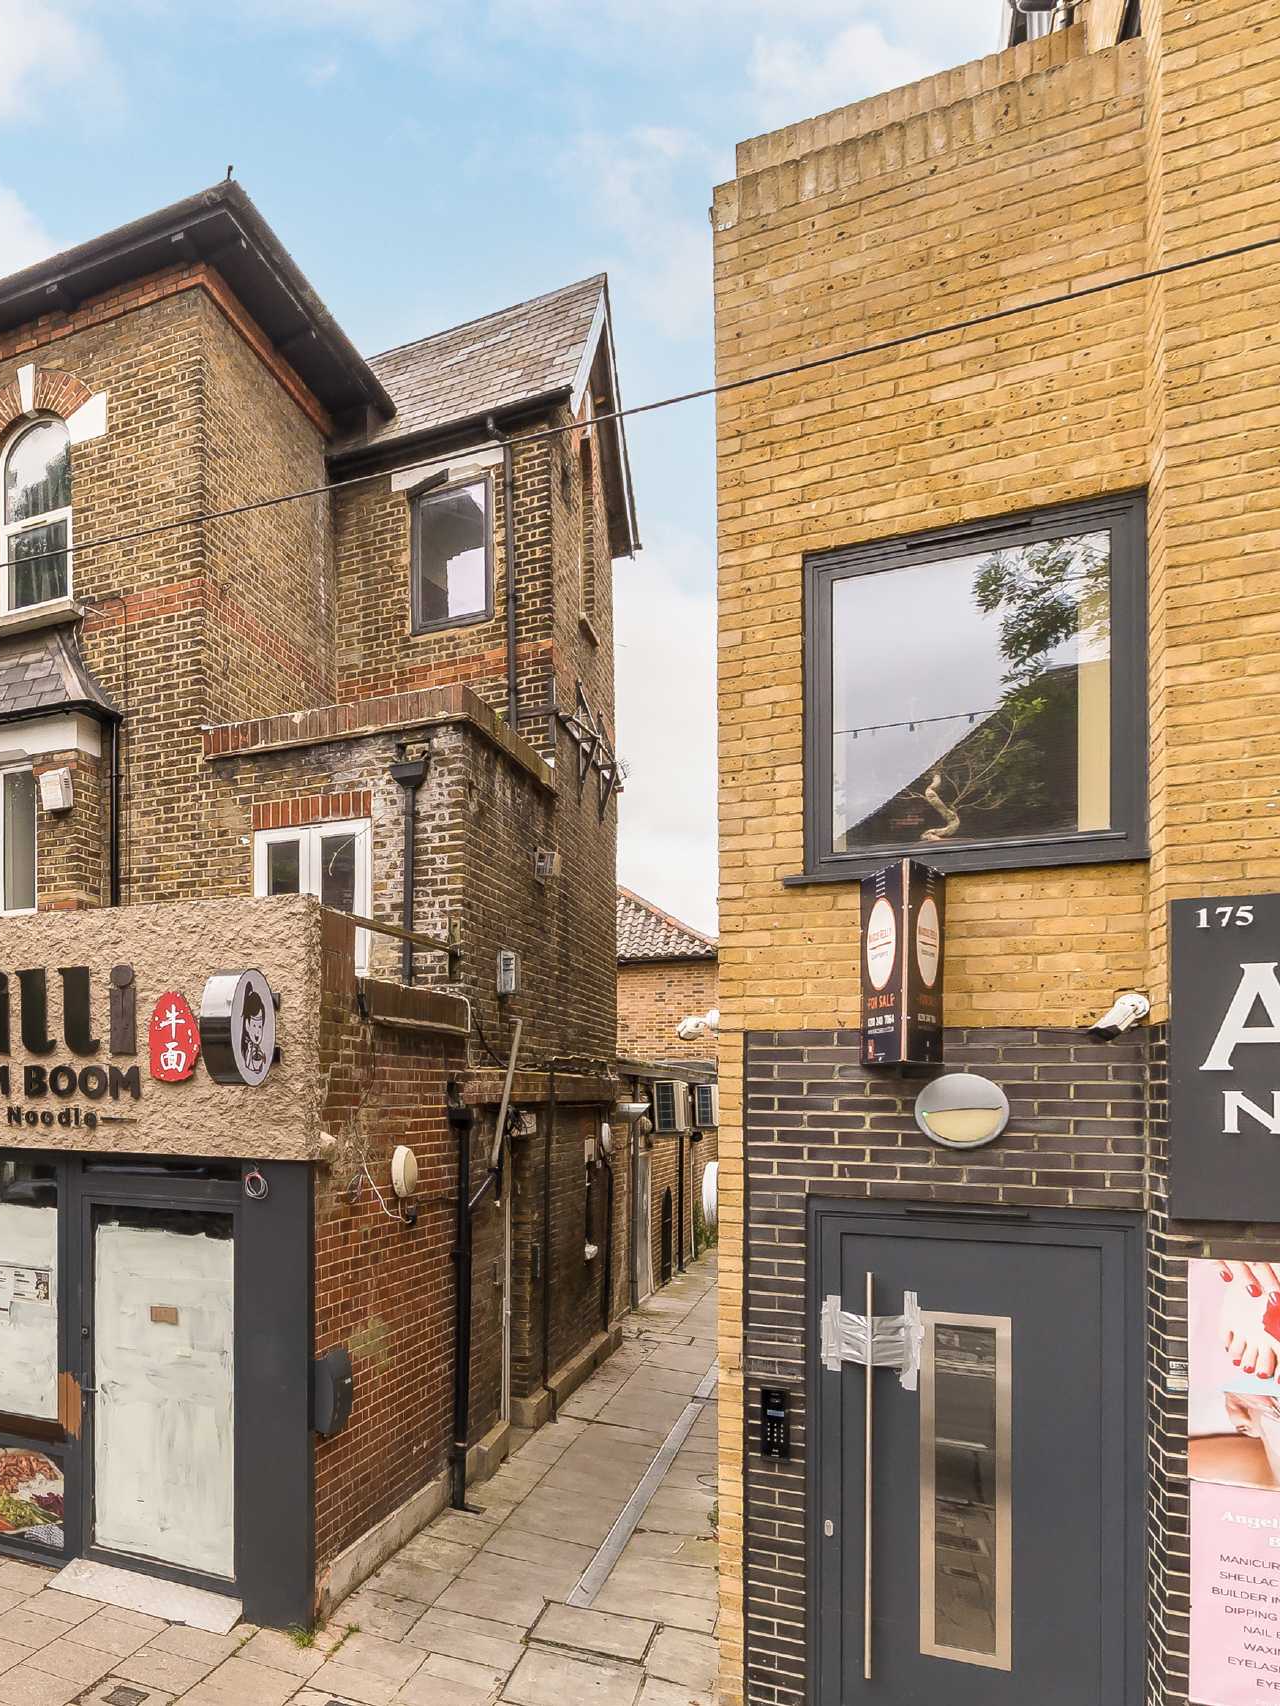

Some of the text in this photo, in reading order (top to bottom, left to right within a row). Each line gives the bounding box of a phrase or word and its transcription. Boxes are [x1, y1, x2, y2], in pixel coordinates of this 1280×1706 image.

[1195, 905, 1254, 928] 175
[879, 993, 895, 1008] SALE
[158, 1003, 187, 1074] 牛面
[23, 1064, 141, 1100] BOOM
[7, 1105, 97, 1130] Noodle
[1222, 1090, 1280, 1134] N
[1221, 1511, 1280, 1529] Angel
[1219, 1554, 1280, 1570] MANICUR
[1219, 1571, 1279, 1587] SHELLAC
[1211, 1586, 1268, 1602] BUILDER
[1224, 1605, 1278, 1621] DIPPING
[1243, 1625, 1272, 1638] NAIL
[1227, 1656, 1280, 1673] EYELAS
[1256, 1678, 1280, 1691] EYE
